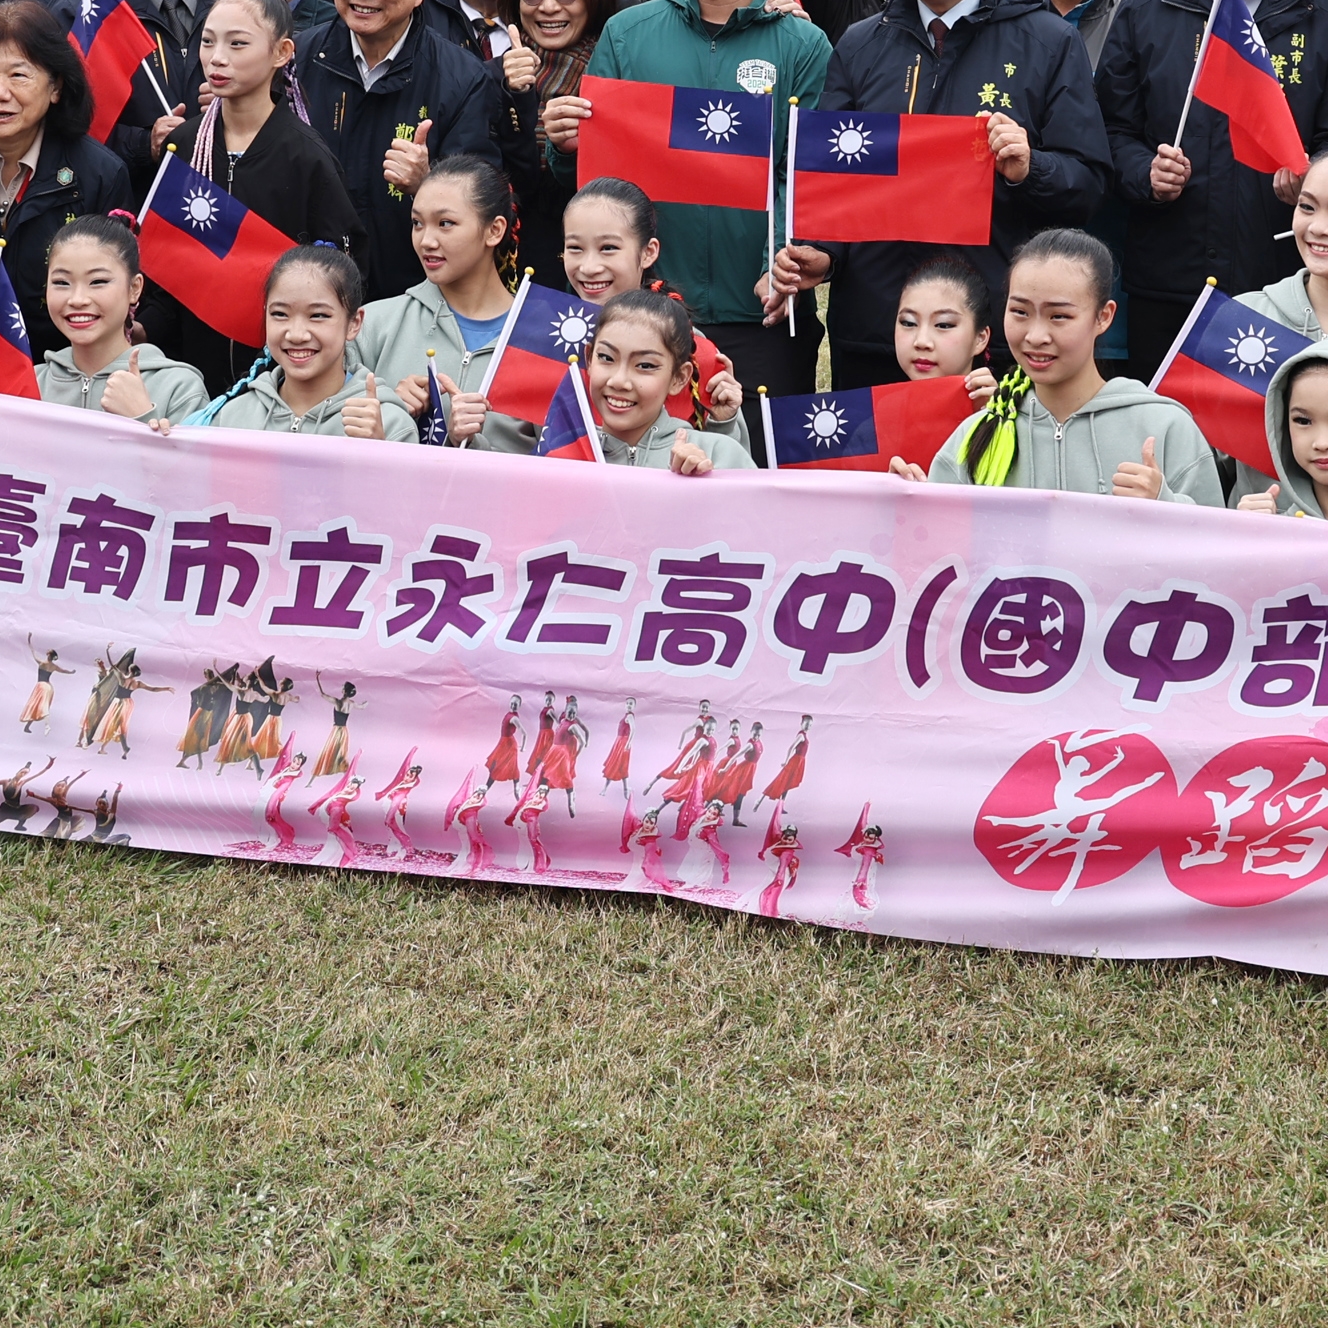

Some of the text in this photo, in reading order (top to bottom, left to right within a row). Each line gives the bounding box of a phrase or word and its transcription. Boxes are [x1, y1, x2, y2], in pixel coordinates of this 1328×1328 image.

[1288, 33, 1305, 84] 副市長
[747, 79, 767, 88] 2024
